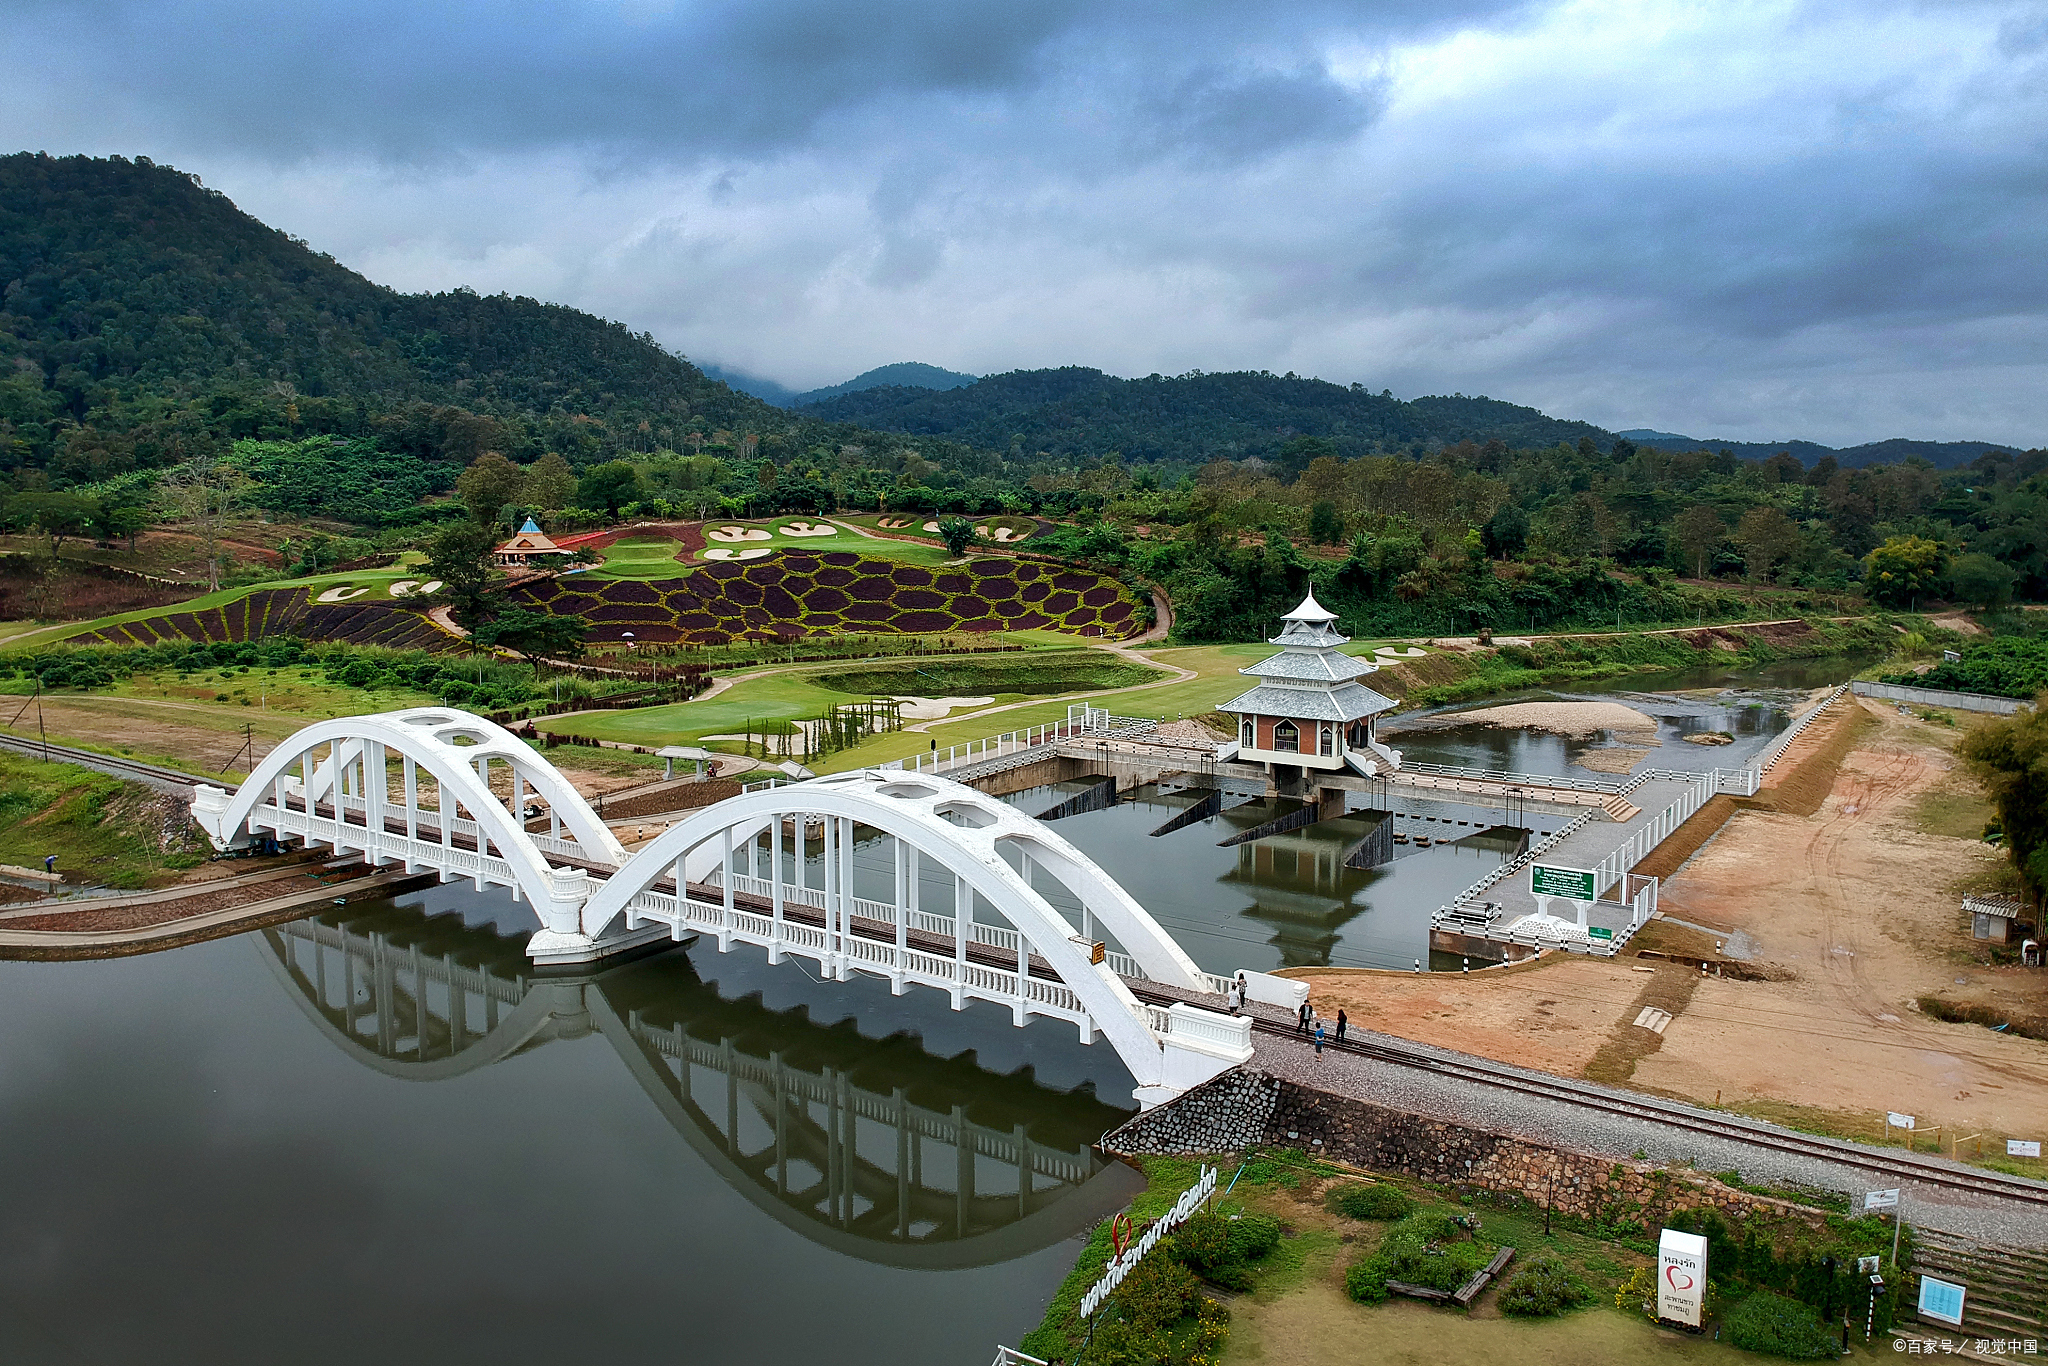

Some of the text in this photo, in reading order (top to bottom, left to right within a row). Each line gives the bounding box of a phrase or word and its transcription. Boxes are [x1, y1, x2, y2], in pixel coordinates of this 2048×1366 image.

[1664, 1256, 1696, 1269] หลงรัก
[1664, 1294, 1694, 1307] สะพานขาว
